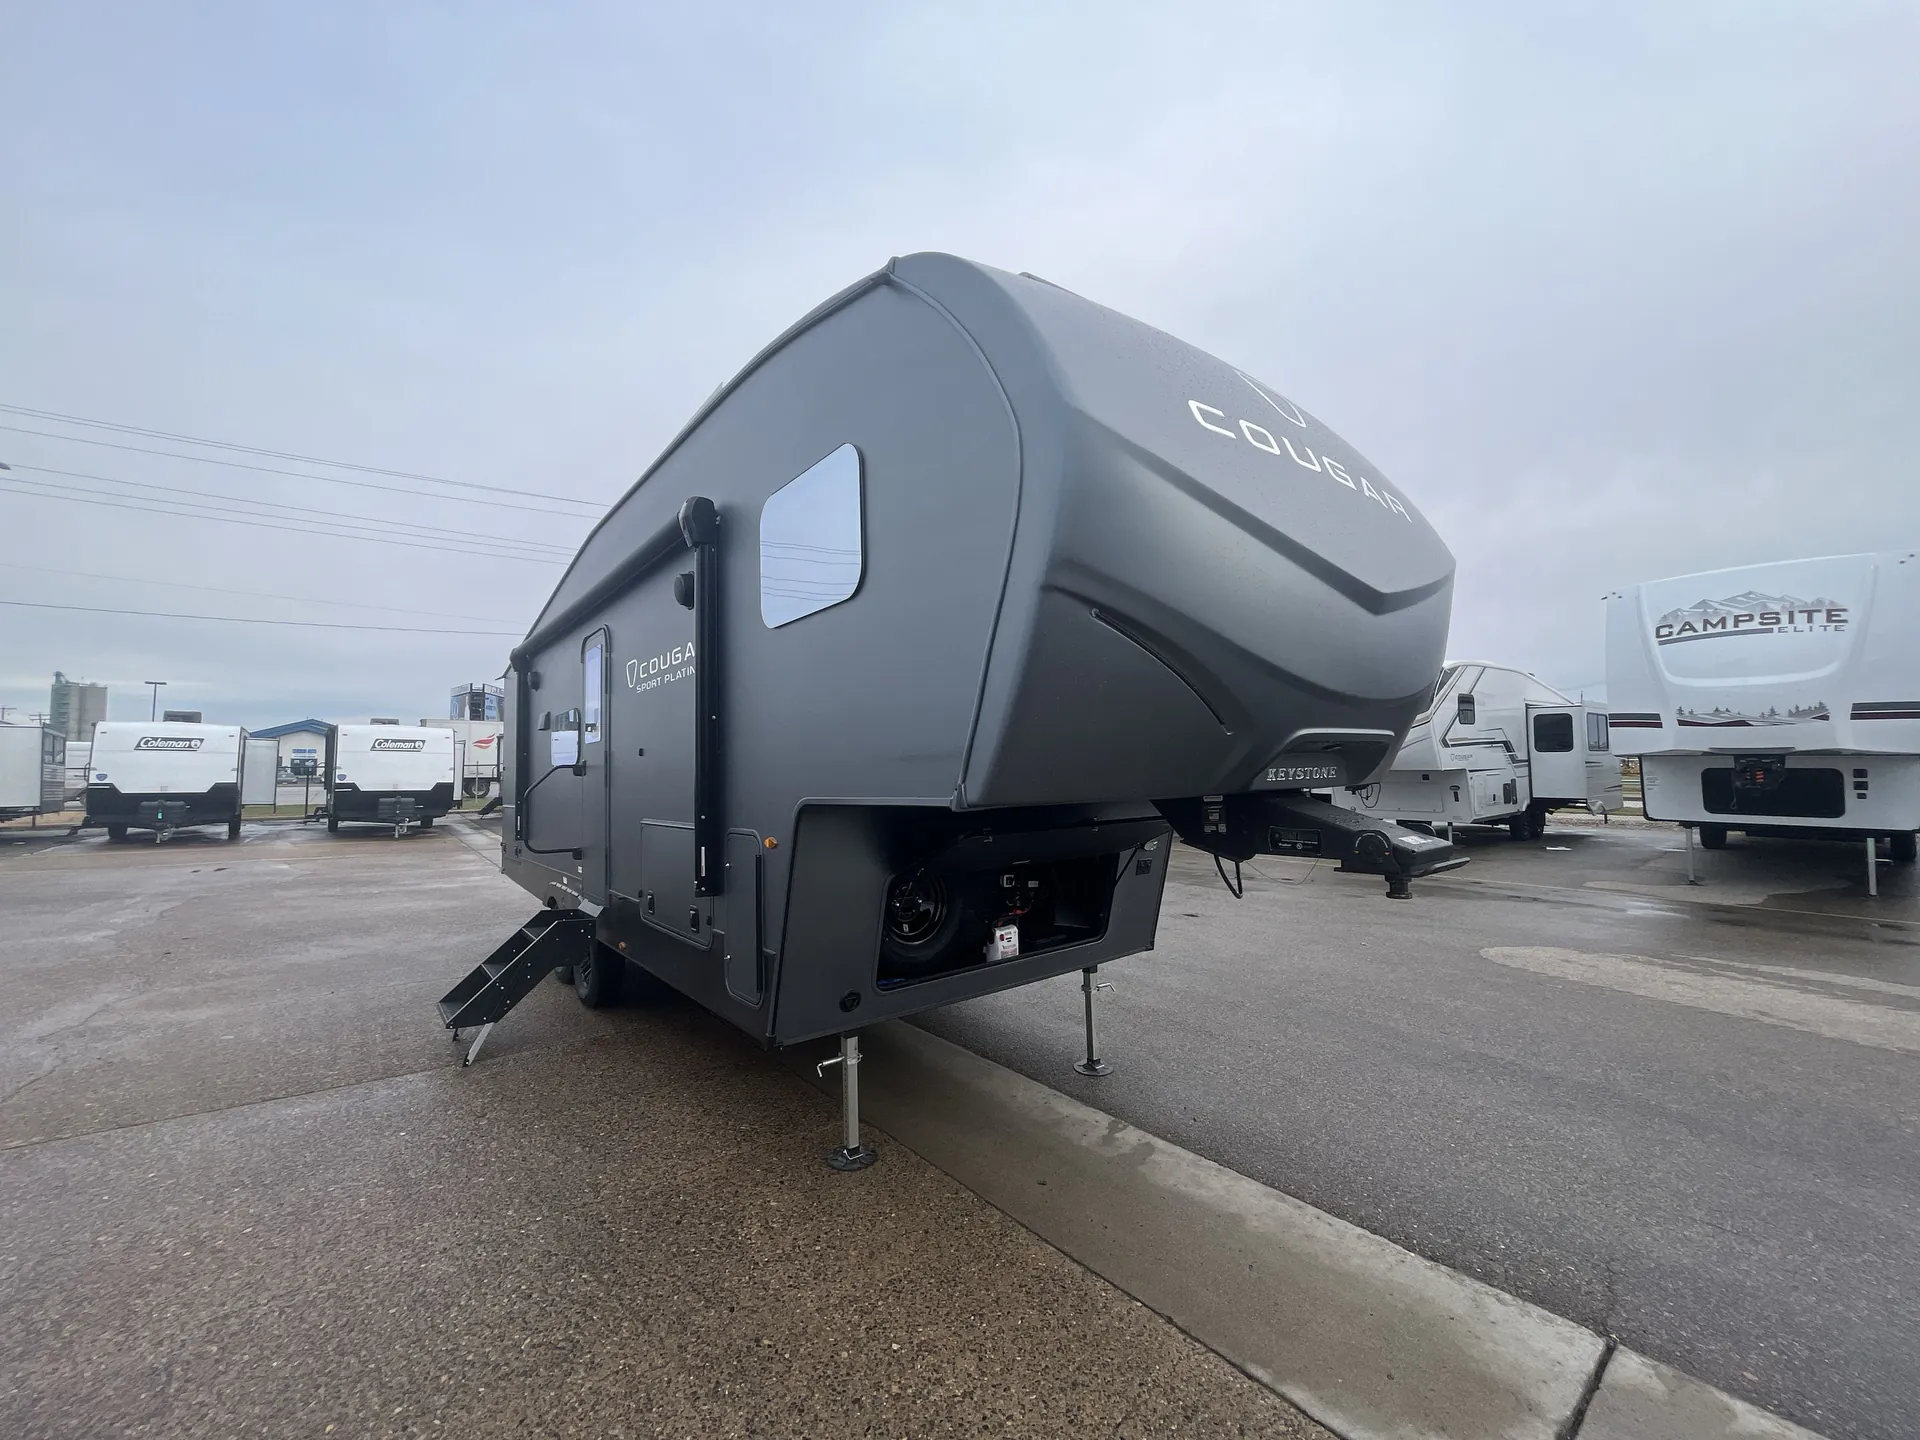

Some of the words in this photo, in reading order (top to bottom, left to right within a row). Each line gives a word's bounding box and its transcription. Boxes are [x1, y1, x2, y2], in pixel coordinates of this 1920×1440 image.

[1187, 399, 1412, 523] COUGAR
[1655, 608, 1849, 639] CAMPSITE
[1777, 625, 1846, 634] ELITE
[640, 641, 695, 679] COUGA
[636, 677, 662, 694] SPORT
[664, 665, 696, 684] PLATIN
[140, 738, 190, 748] Coleman
[375, 739, 415, 749] Coleman
[1266, 766, 1337, 781] KEYSTONE
